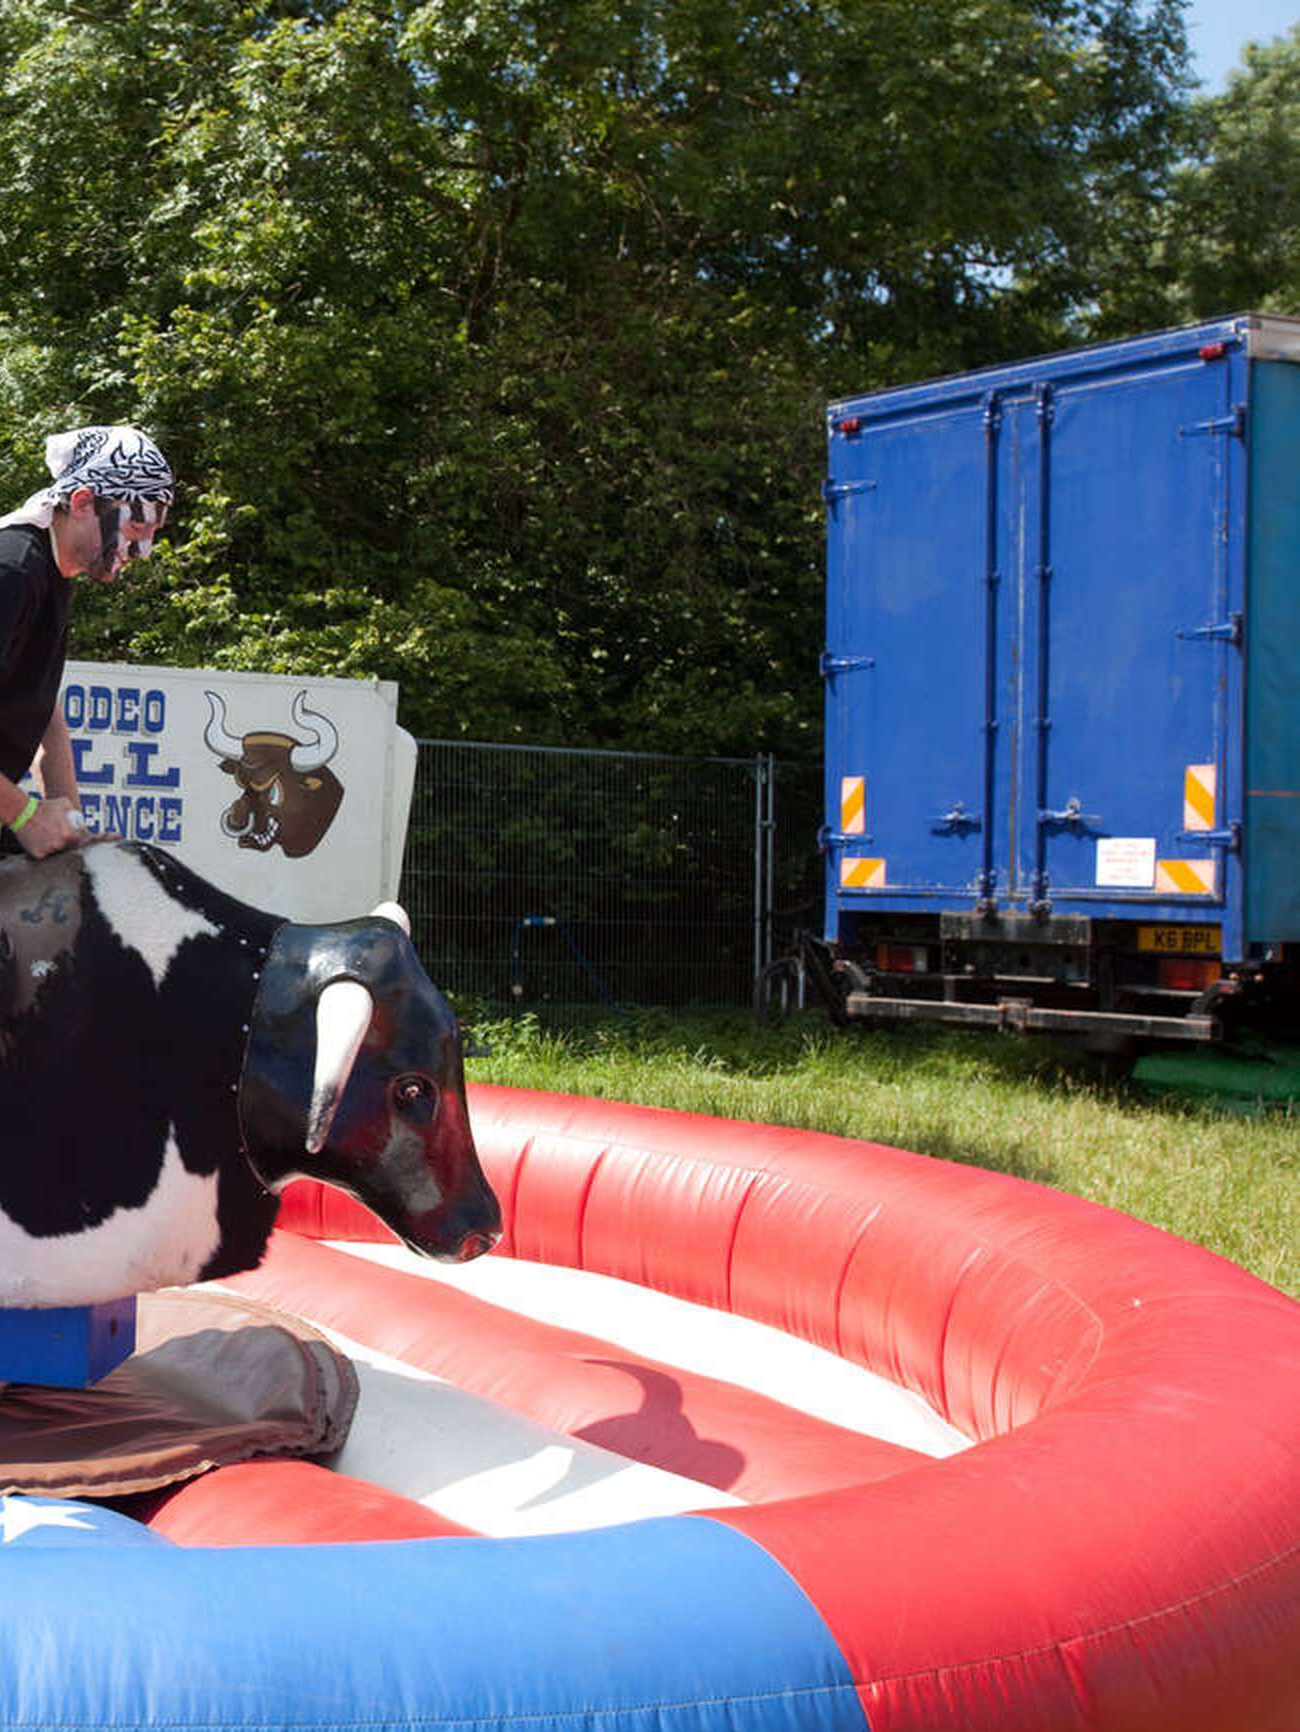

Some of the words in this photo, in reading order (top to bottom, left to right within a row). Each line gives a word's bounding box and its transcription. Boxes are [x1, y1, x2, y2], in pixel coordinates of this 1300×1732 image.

[64, 685, 166, 733] ODEO
[71, 739, 180, 787] LL
[79, 794, 183, 842] ENCE
